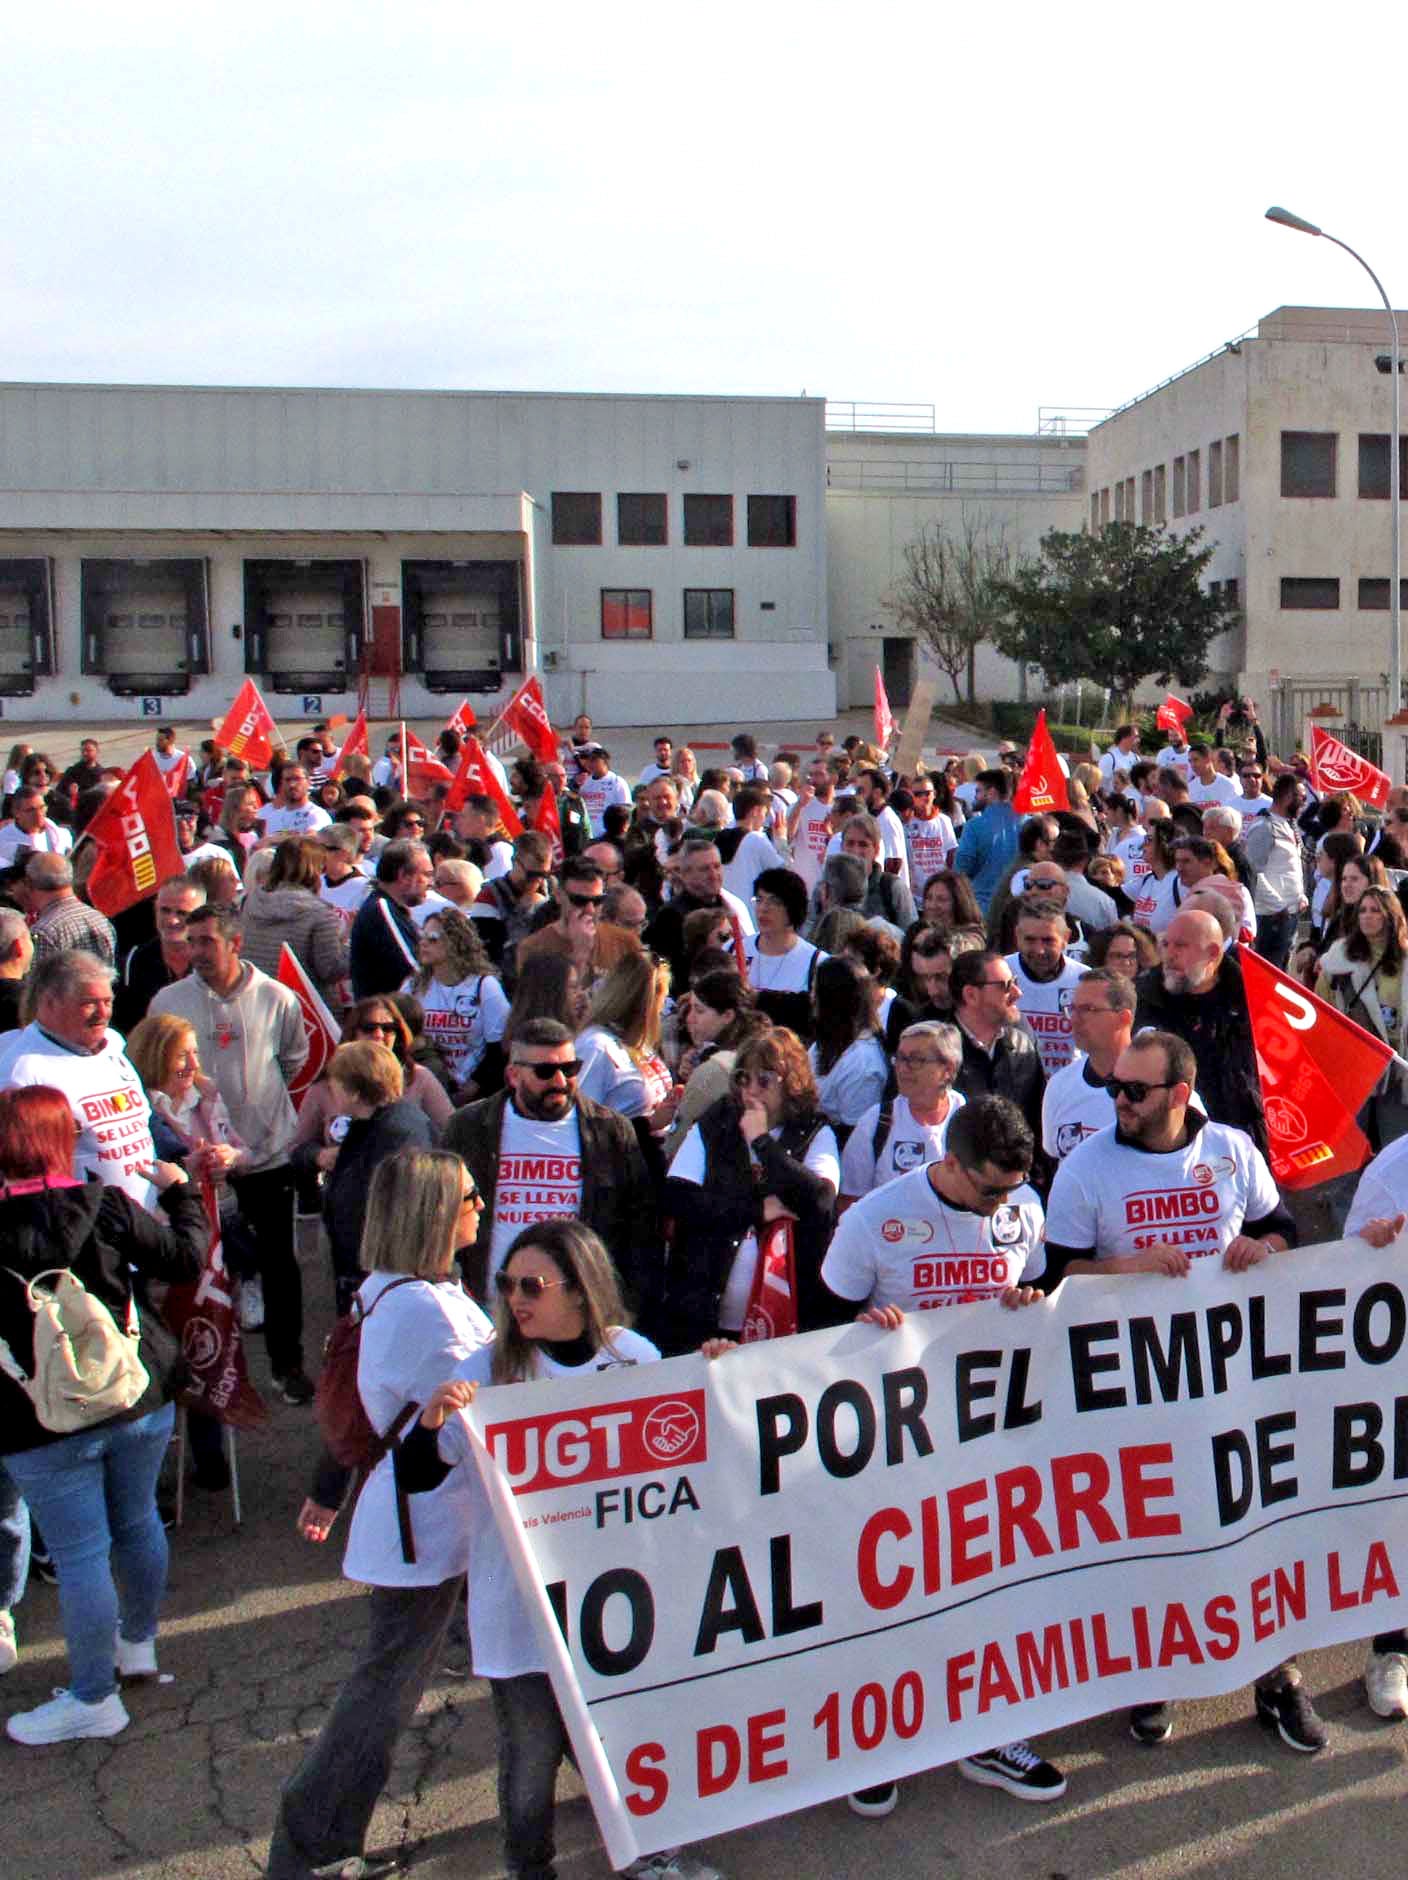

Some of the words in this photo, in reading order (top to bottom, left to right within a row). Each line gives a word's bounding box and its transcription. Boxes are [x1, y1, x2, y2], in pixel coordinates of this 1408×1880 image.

[97, 1128, 117, 1144] SE
[497, 1160, 583, 1181] BIMBO
[500, 1191, 520, 1204] SE
[525, 1191, 577, 1204] LLEVA
[1125, 1190, 1220, 1224] BIMBO
[913, 1258, 1009, 1288] BIMBO
[756, 1367, 934, 1496] POR
[955, 1347, 1042, 1443] EL
[1068, 1281, 1407, 1412] EMPLEO
[494, 1411, 633, 1488] UGT
[596, 1476, 701, 1529] FICA
[694, 1534, 823, 1657] AL
[857, 1443, 1182, 1610] CIERRE
[1211, 1411, 1298, 1528] DE
[696, 1708, 789, 1799] DE
[813, 1670, 925, 1761] 100
[946, 1595, 1241, 1723] FAMILIAS
[1251, 1561, 1306, 1643] EN
[1327, 1541, 1401, 1612] LA
